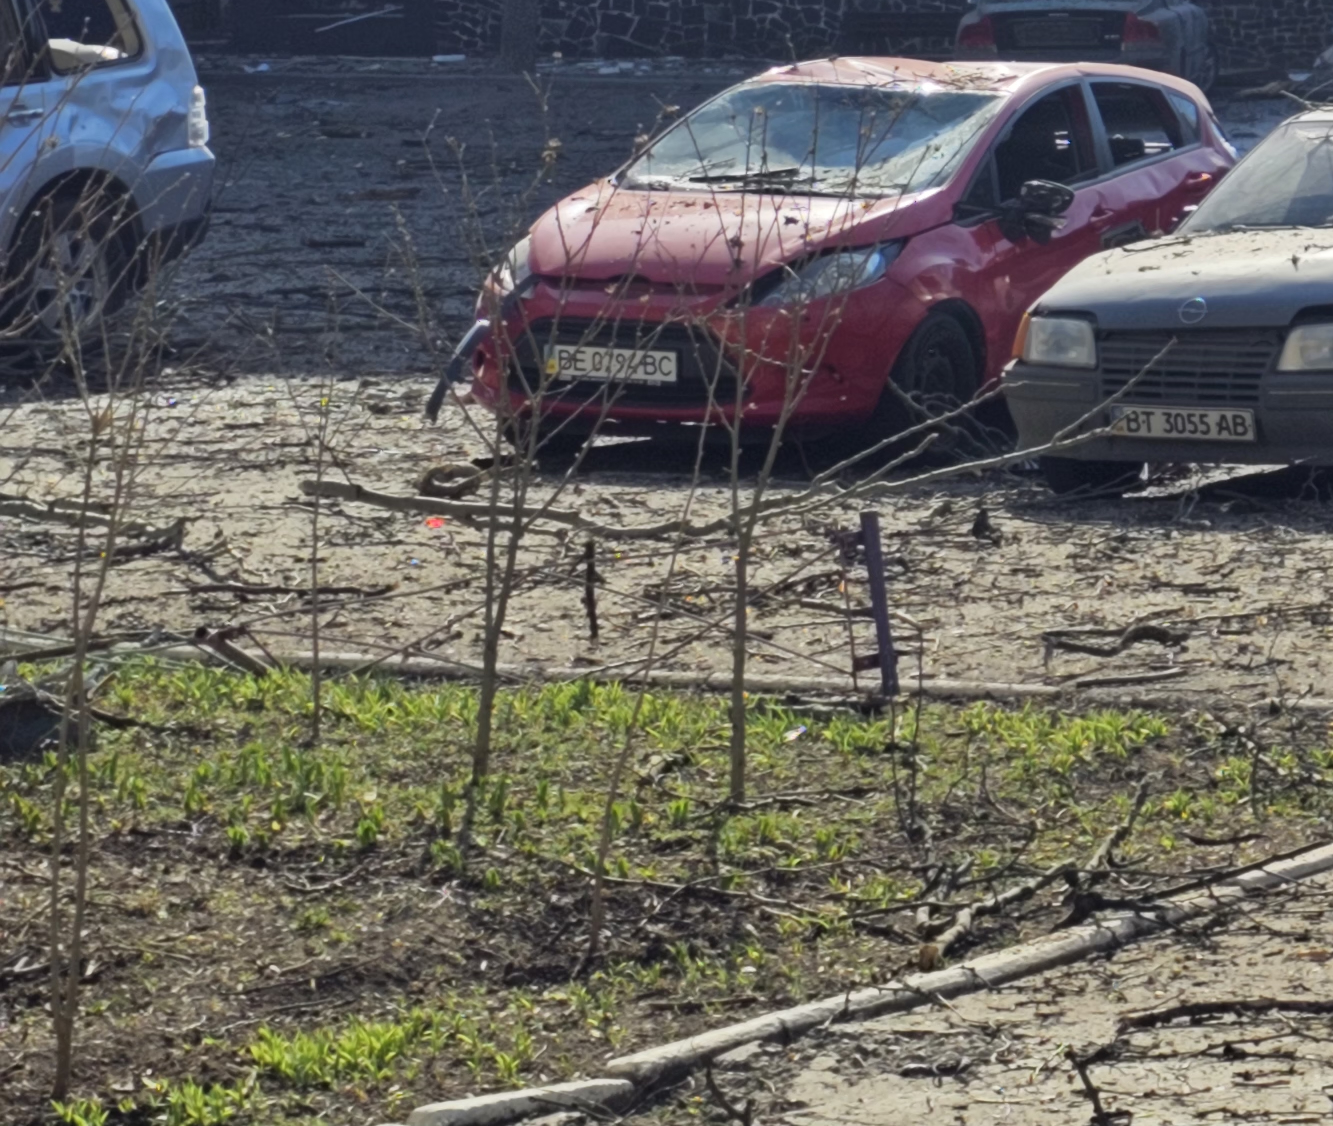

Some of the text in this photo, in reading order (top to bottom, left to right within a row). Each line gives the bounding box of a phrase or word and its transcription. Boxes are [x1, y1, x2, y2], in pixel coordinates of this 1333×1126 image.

[558, 349, 586, 372] BE
[644, 354, 672, 376] BC
[1126, 410, 1248, 437] BT 3055 AB
